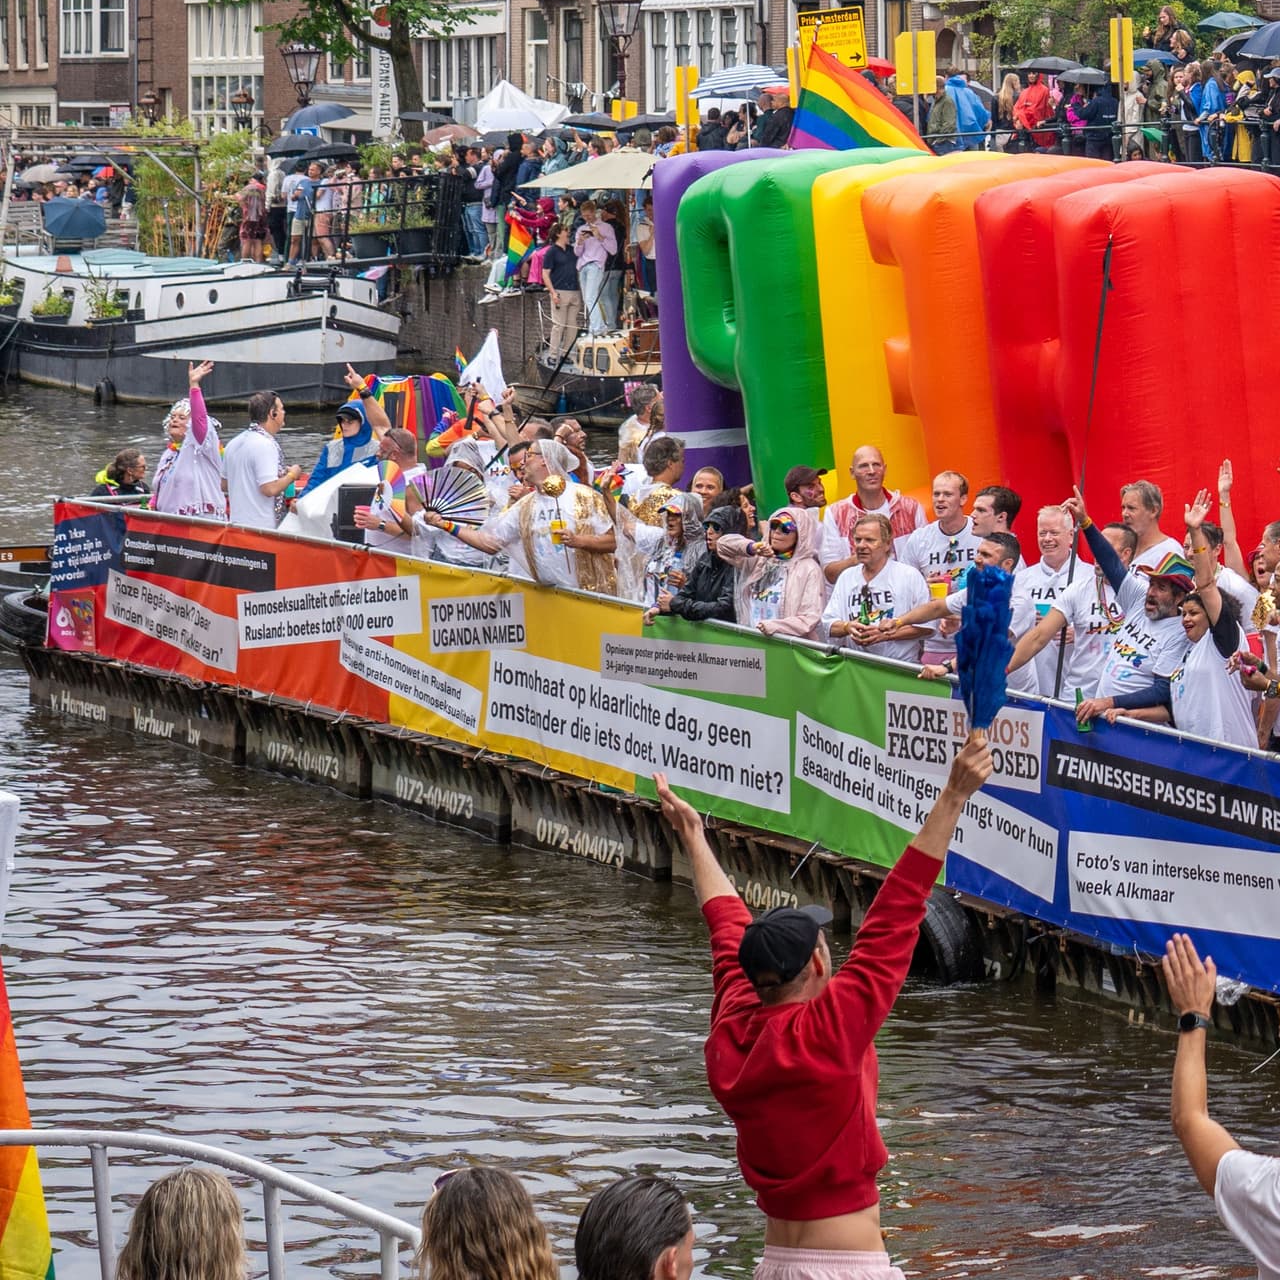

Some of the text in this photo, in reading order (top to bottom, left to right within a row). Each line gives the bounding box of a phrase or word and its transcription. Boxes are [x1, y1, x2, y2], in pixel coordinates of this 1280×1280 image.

[820, 11, 859, 24] Amsterdam
[124, 552, 155, 566] Tennessee
[225, 554, 261, 570] spanningen
[929, 547, 975, 565] HATE
[244, 583, 409, 617] Homoseksualiteit officieel taboe in
[431, 599, 512, 623] TOP HOMOS IN
[1031, 587, 1066, 600] HAT
[112, 601, 143, 626] vinden
[155, 621, 179, 643] geen
[244, 621, 286, 642] Rusland:
[286, 619, 320, 636] boetes
[321, 617, 335, 634] tot
[366, 615, 394, 630] euro
[432, 624, 526, 648] UGANDA NAMED
[364, 646, 421, 682] anti-homowet
[420, 670, 430, 685] in
[430, 674, 462, 701] Rusland
[605, 642, 763, 672] Opnieuw poster pride-week Alkmaar vernield,
[605, 661, 698, 681] 34-jarige man aangehouden
[365, 665, 393, 688] praten
[394, 678, 412, 694] over
[413, 687, 477, 730] homoseksualiteit
[493, 661, 752, 750] Homohaat op klaarlichte dag, geen
[132, 706, 175, 739] Verhuur
[887, 702, 1030, 749] MORE HMO'S
[266, 740, 340, 780] 0172-604073
[490, 699, 785, 797] omstander die iets doet. Waarom niet?
[887, 731, 948, 766] FACES
[396, 773, 474, 820] 0172-604073
[801, 755, 875, 810] geaardheid
[876, 789, 895, 814] uit
[897, 799, 913, 820] te
[802, 724, 844, 762] School
[847, 746, 873, 771] die
[874, 754, 941, 802] leerlingen
[996, 815, 1027, 844] voor
[1028, 825, 1055, 859] hun
[1056, 753, 1151, 798] TENNESSEE
[1153, 780, 1217, 815] PASSES
[1219, 797, 1259, 826] LAW
[536, 817, 626, 869] 0172-604073
[1076, 851, 1121, 872] Foto's
[1123, 859, 1149, 876] van
[1151, 857, 1221, 884] intersekse
[1222, 871, 1275, 891] mensen
[1075, 878, 1176, 904] week Alkmaar
